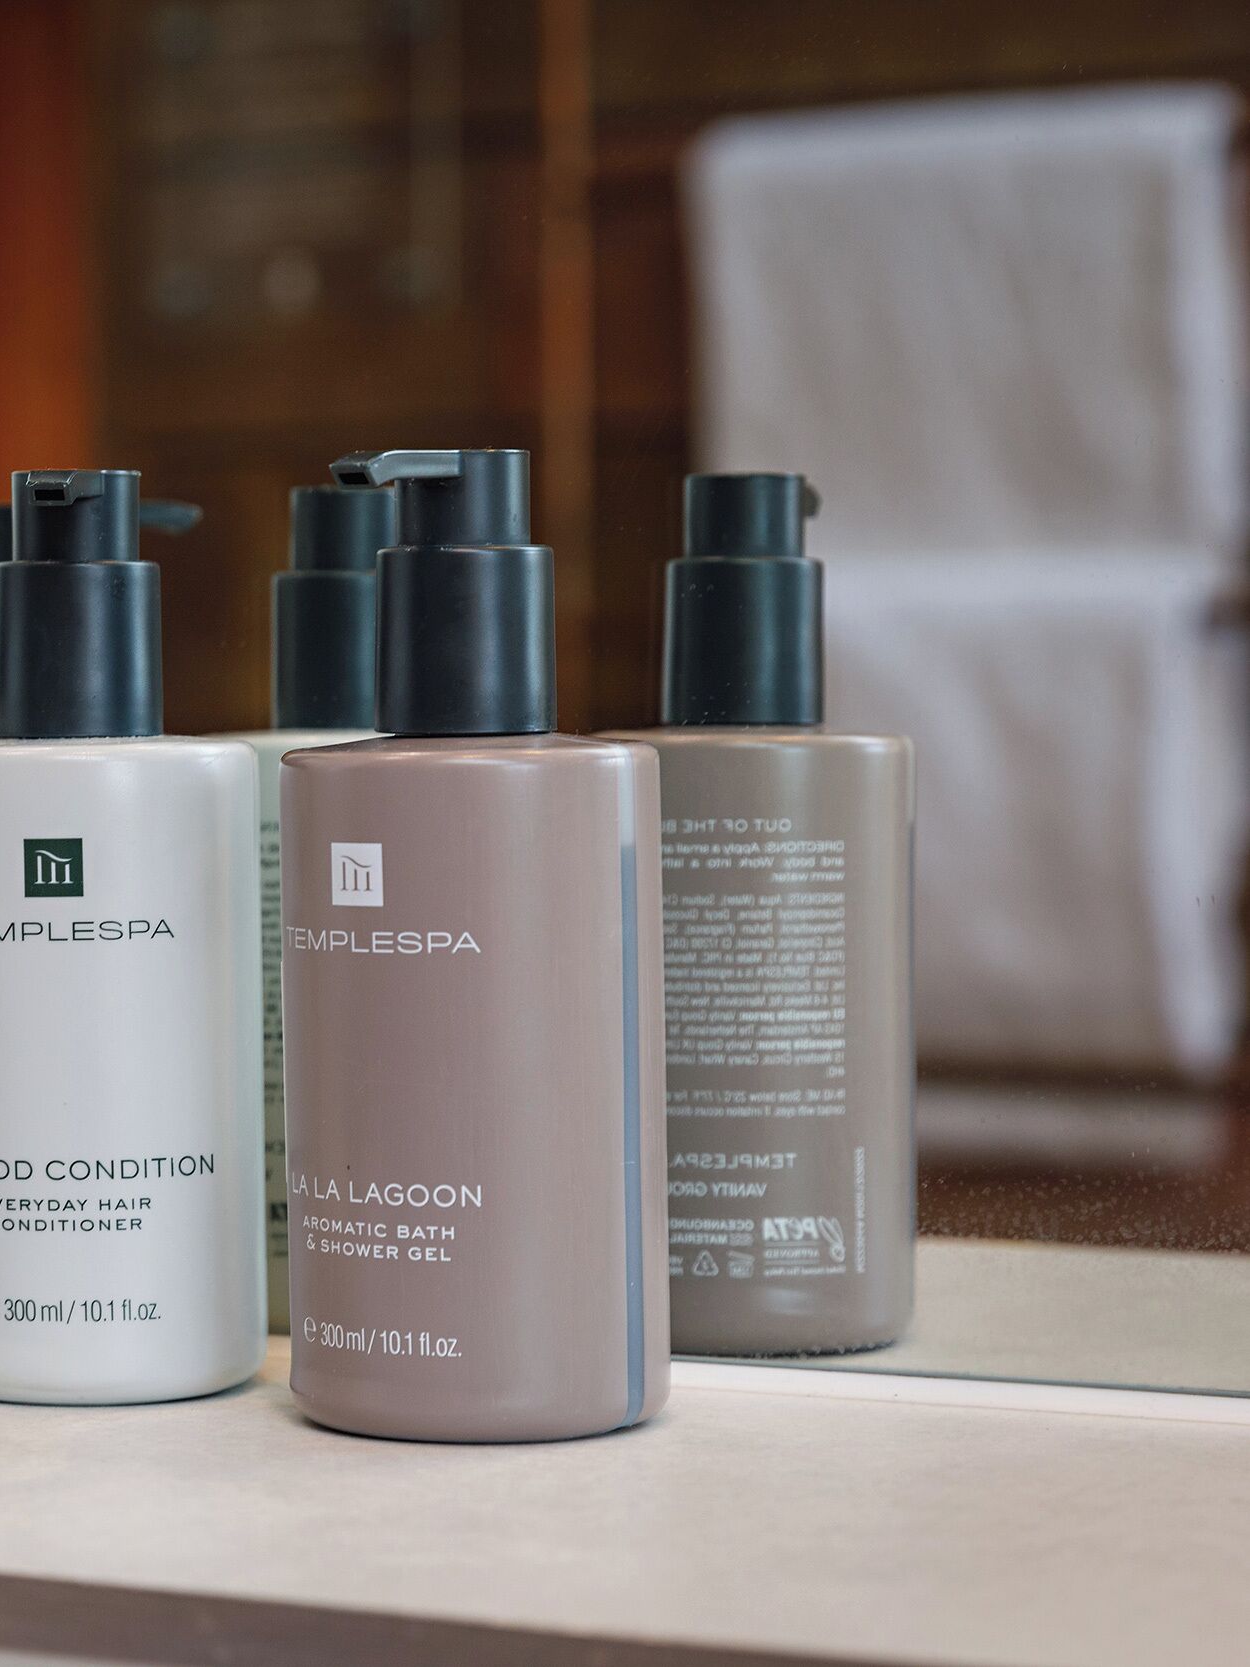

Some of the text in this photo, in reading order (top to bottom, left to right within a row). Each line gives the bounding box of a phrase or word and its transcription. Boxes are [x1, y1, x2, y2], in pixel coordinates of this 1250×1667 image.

[287, 927, 480, 953] TEMPLESPA
[46, 1154, 213, 1180] CONDITION
[292, 1172, 481, 1207] LA LA LAGOON
[99, 1198, 150, 1210] HAIR
[303, 1216, 454, 1240] AROMATIC BATH
[307, 1234, 451, 1261] & SHOWER GEL
